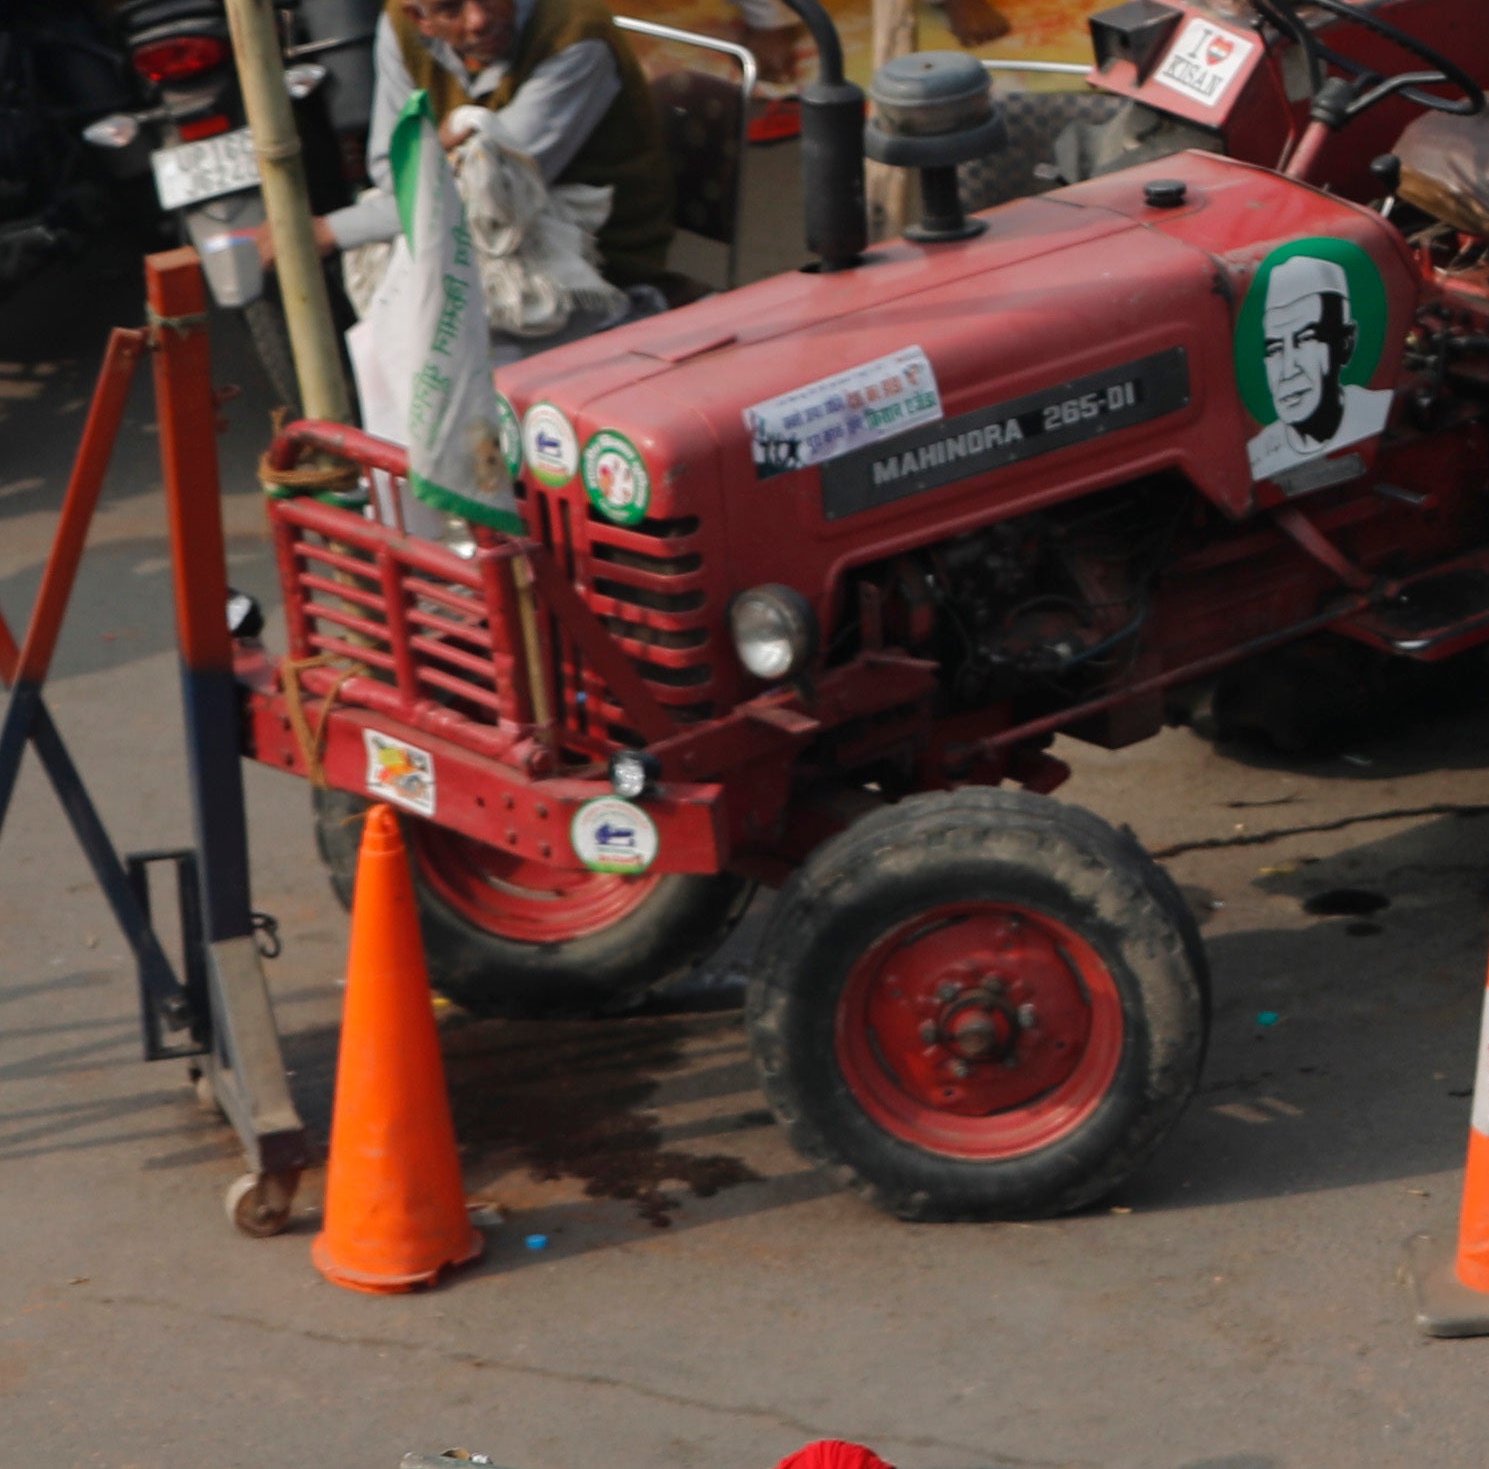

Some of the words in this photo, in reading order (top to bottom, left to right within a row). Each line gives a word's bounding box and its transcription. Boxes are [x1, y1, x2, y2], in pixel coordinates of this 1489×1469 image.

[1162, 53, 1224, 97] KISAN
[872, 418, 1024, 485] MAHINDRA
[1043, 381, 1136, 432] 265-DI
